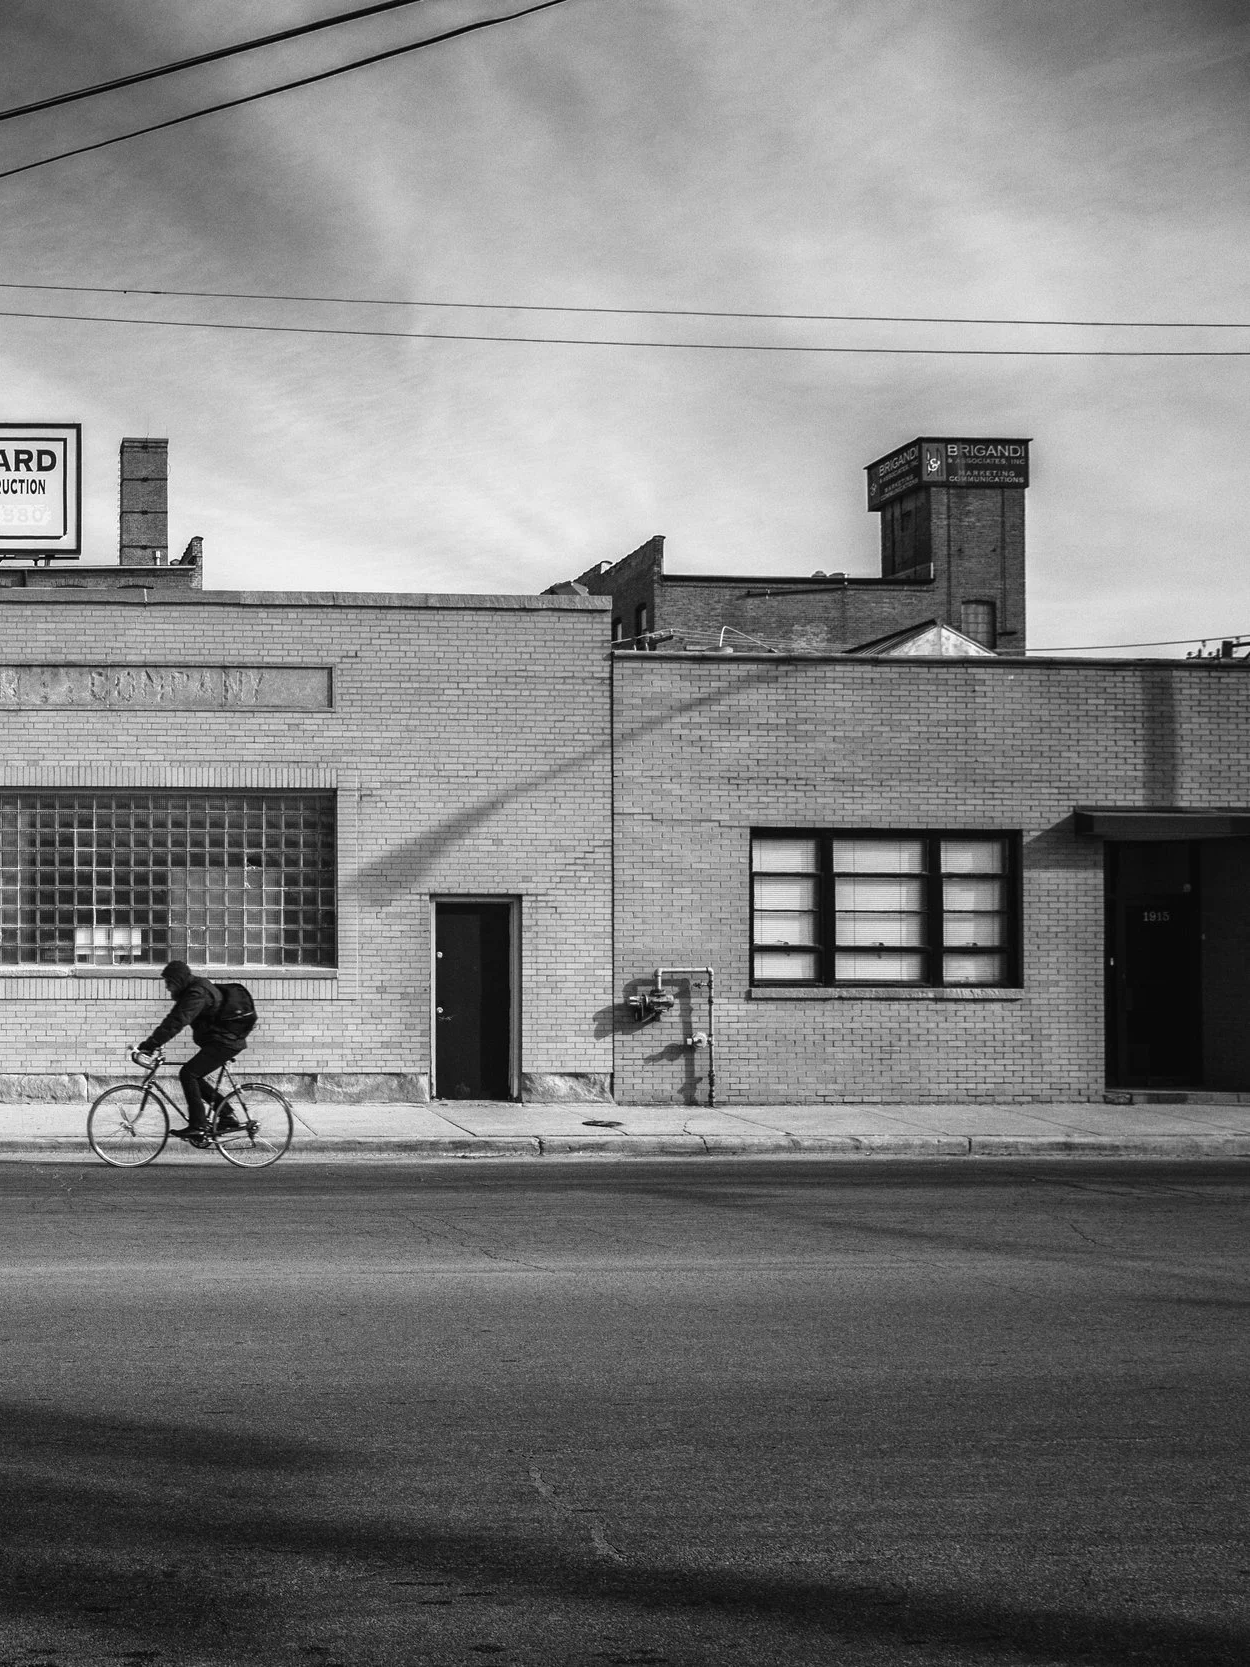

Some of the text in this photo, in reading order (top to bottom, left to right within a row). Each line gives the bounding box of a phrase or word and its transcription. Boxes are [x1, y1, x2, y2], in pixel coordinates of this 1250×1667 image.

[947, 444, 1025, 457] BRIGANDI
[879, 445, 919, 477] BRIGANDI
[949, 475, 1025, 483] COMMUNICATIONS
[1142, 911, 1170, 922] 1915
